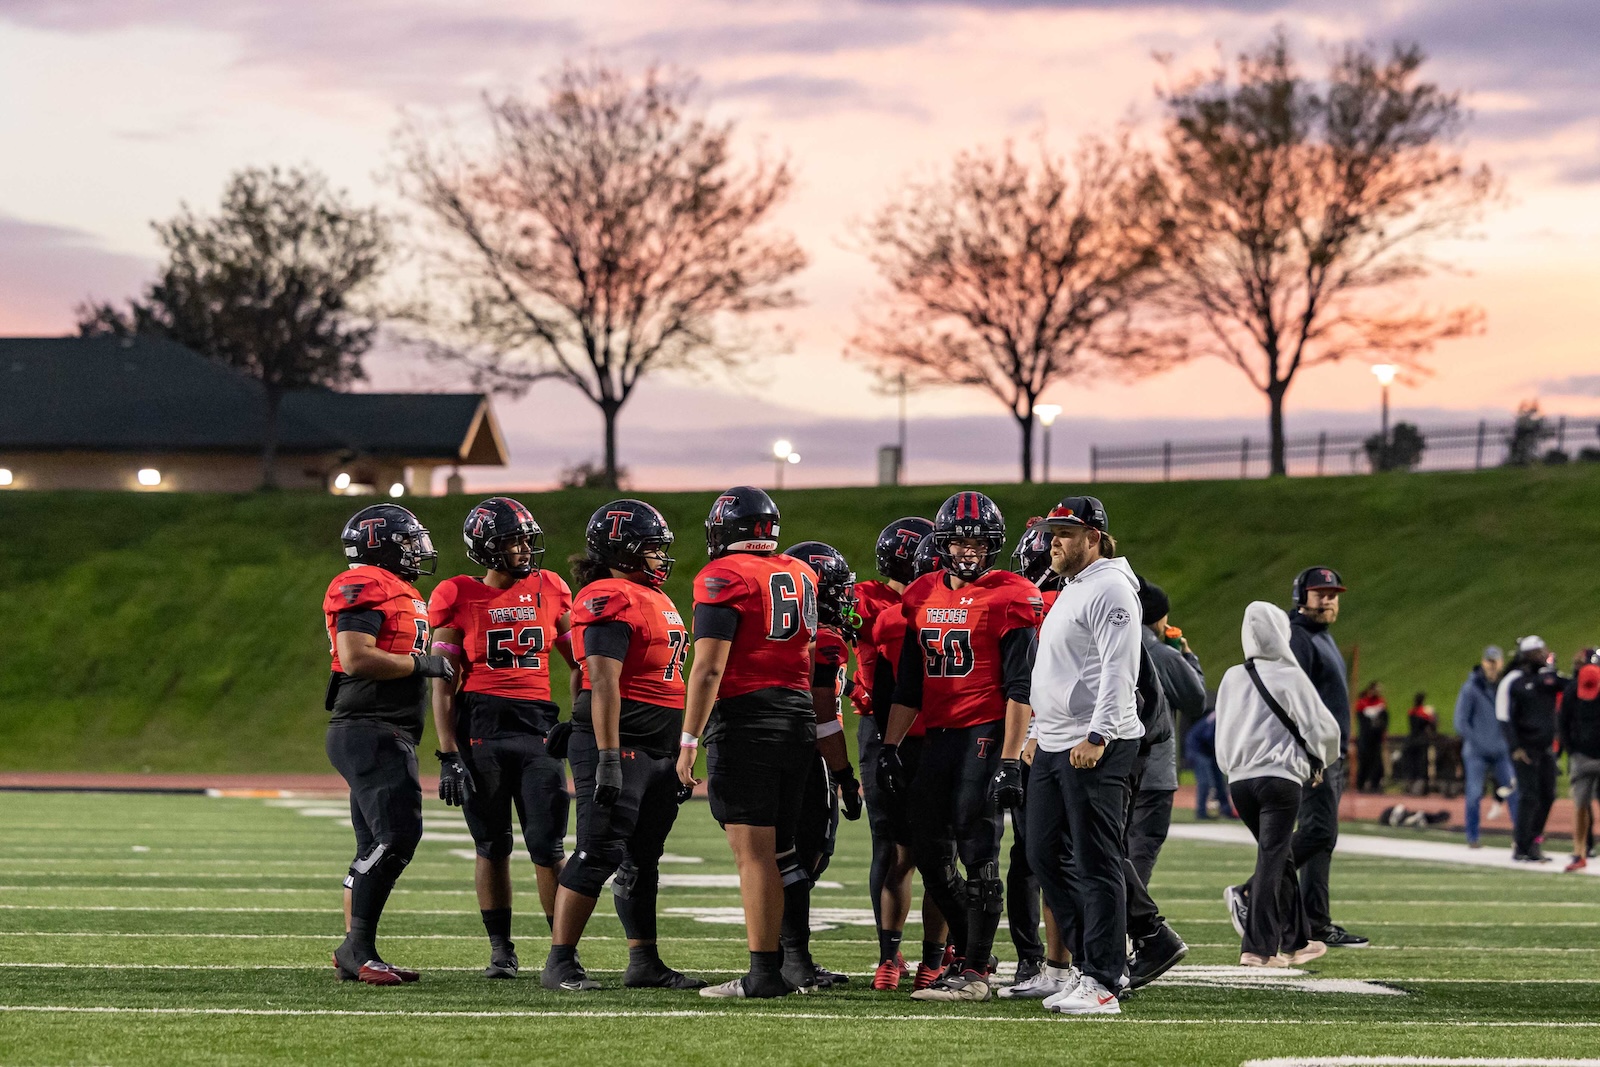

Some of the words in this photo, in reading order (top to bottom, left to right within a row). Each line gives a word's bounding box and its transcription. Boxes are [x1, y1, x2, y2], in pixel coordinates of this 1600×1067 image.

[473, 508, 497, 538] T
[713, 496, 736, 525] T
[360, 518, 386, 548] T
[606, 511, 633, 541] T
[895, 528, 922, 559] T
[809, 555, 836, 585] T
[1320, 569, 1334, 582] T
[488, 606, 536, 624] TASCOSA
[766, 572, 818, 643] 64
[926, 608, 968, 624] TASCOSA
[486, 627, 544, 670] 52
[919, 628, 975, 678] 50
[976, 738, 995, 759] T
